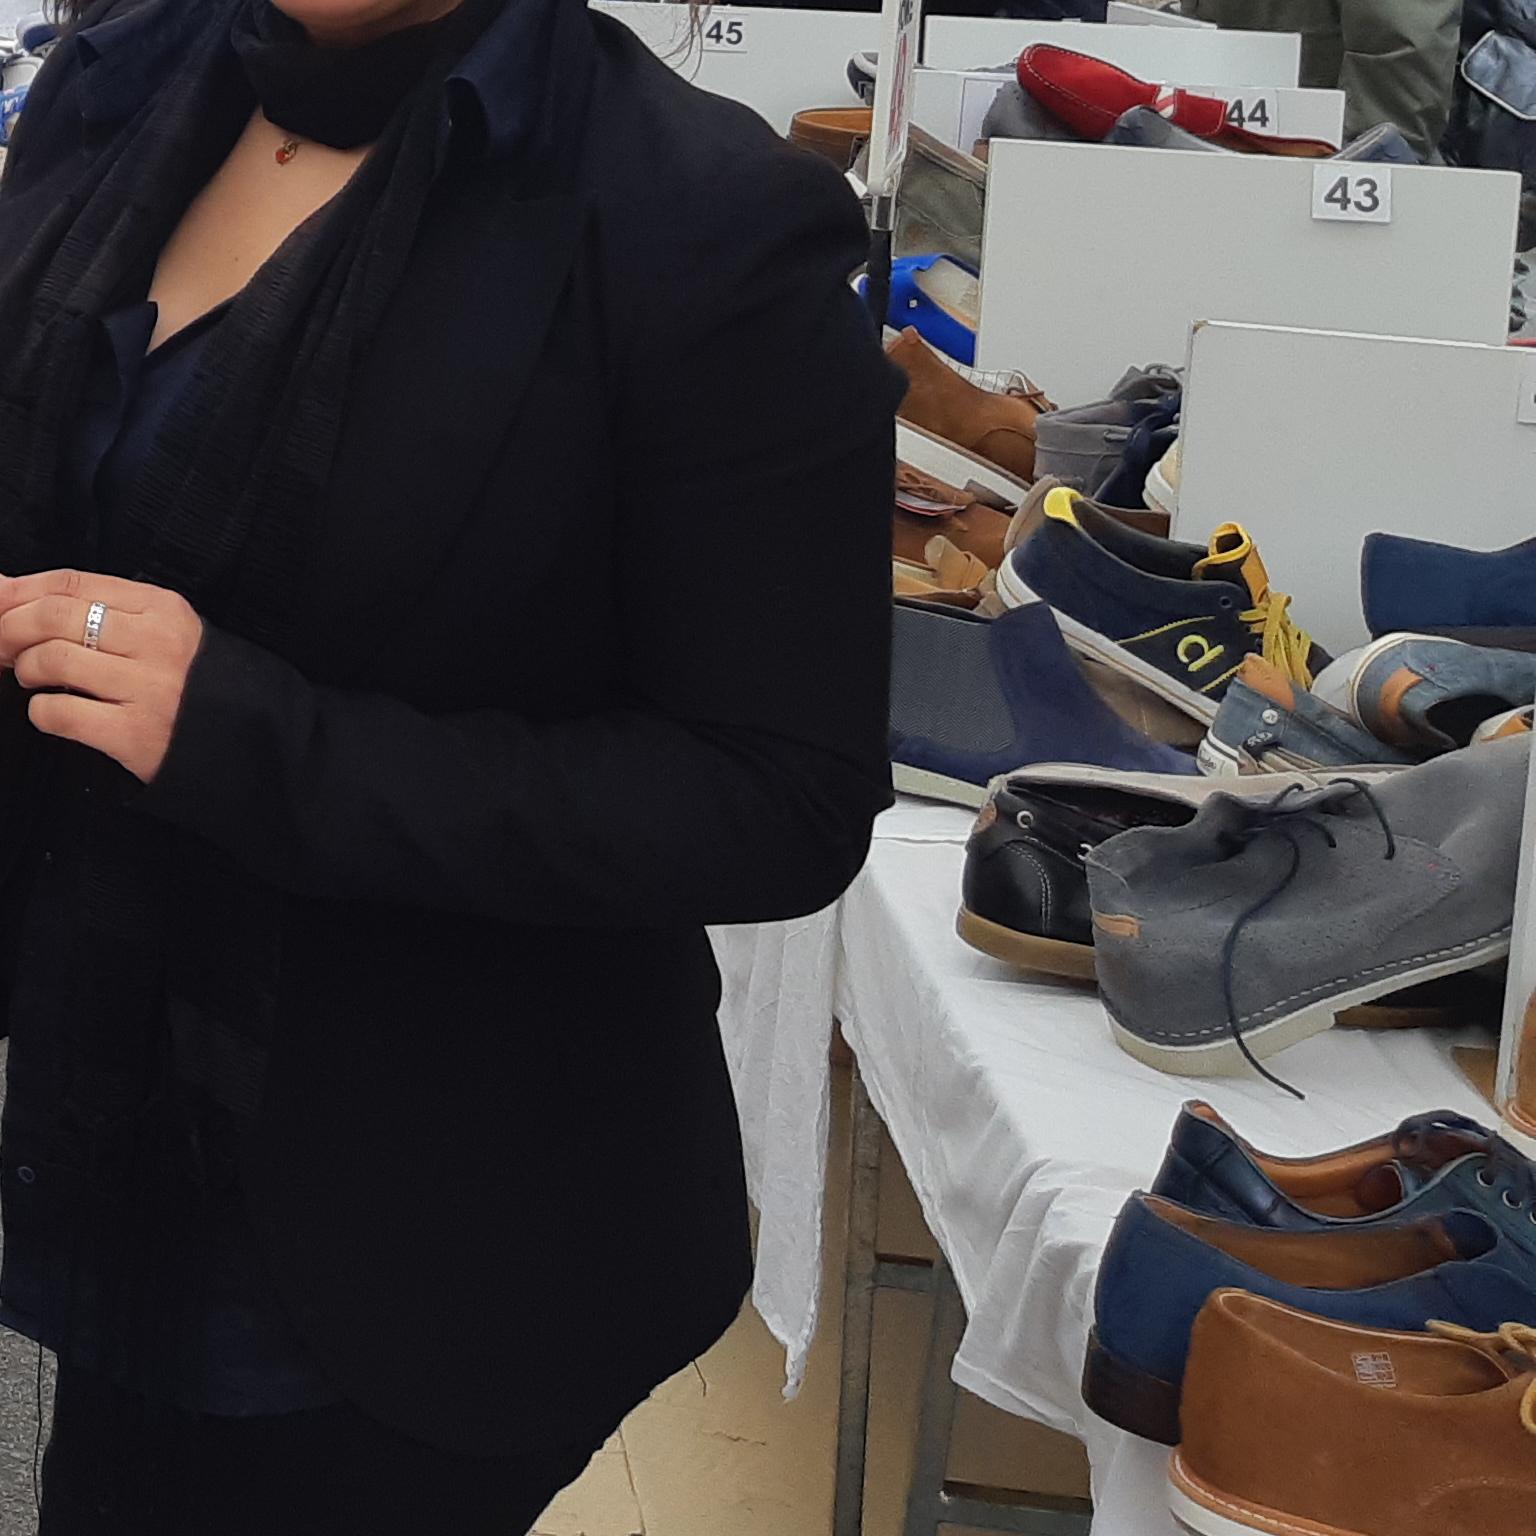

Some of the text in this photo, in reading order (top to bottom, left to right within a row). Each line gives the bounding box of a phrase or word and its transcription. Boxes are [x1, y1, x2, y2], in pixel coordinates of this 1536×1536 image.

[705, 19, 744, 46] 45
[1227, 98, 1270, 128] 44
[1324, 176, 1380, 213] 43
